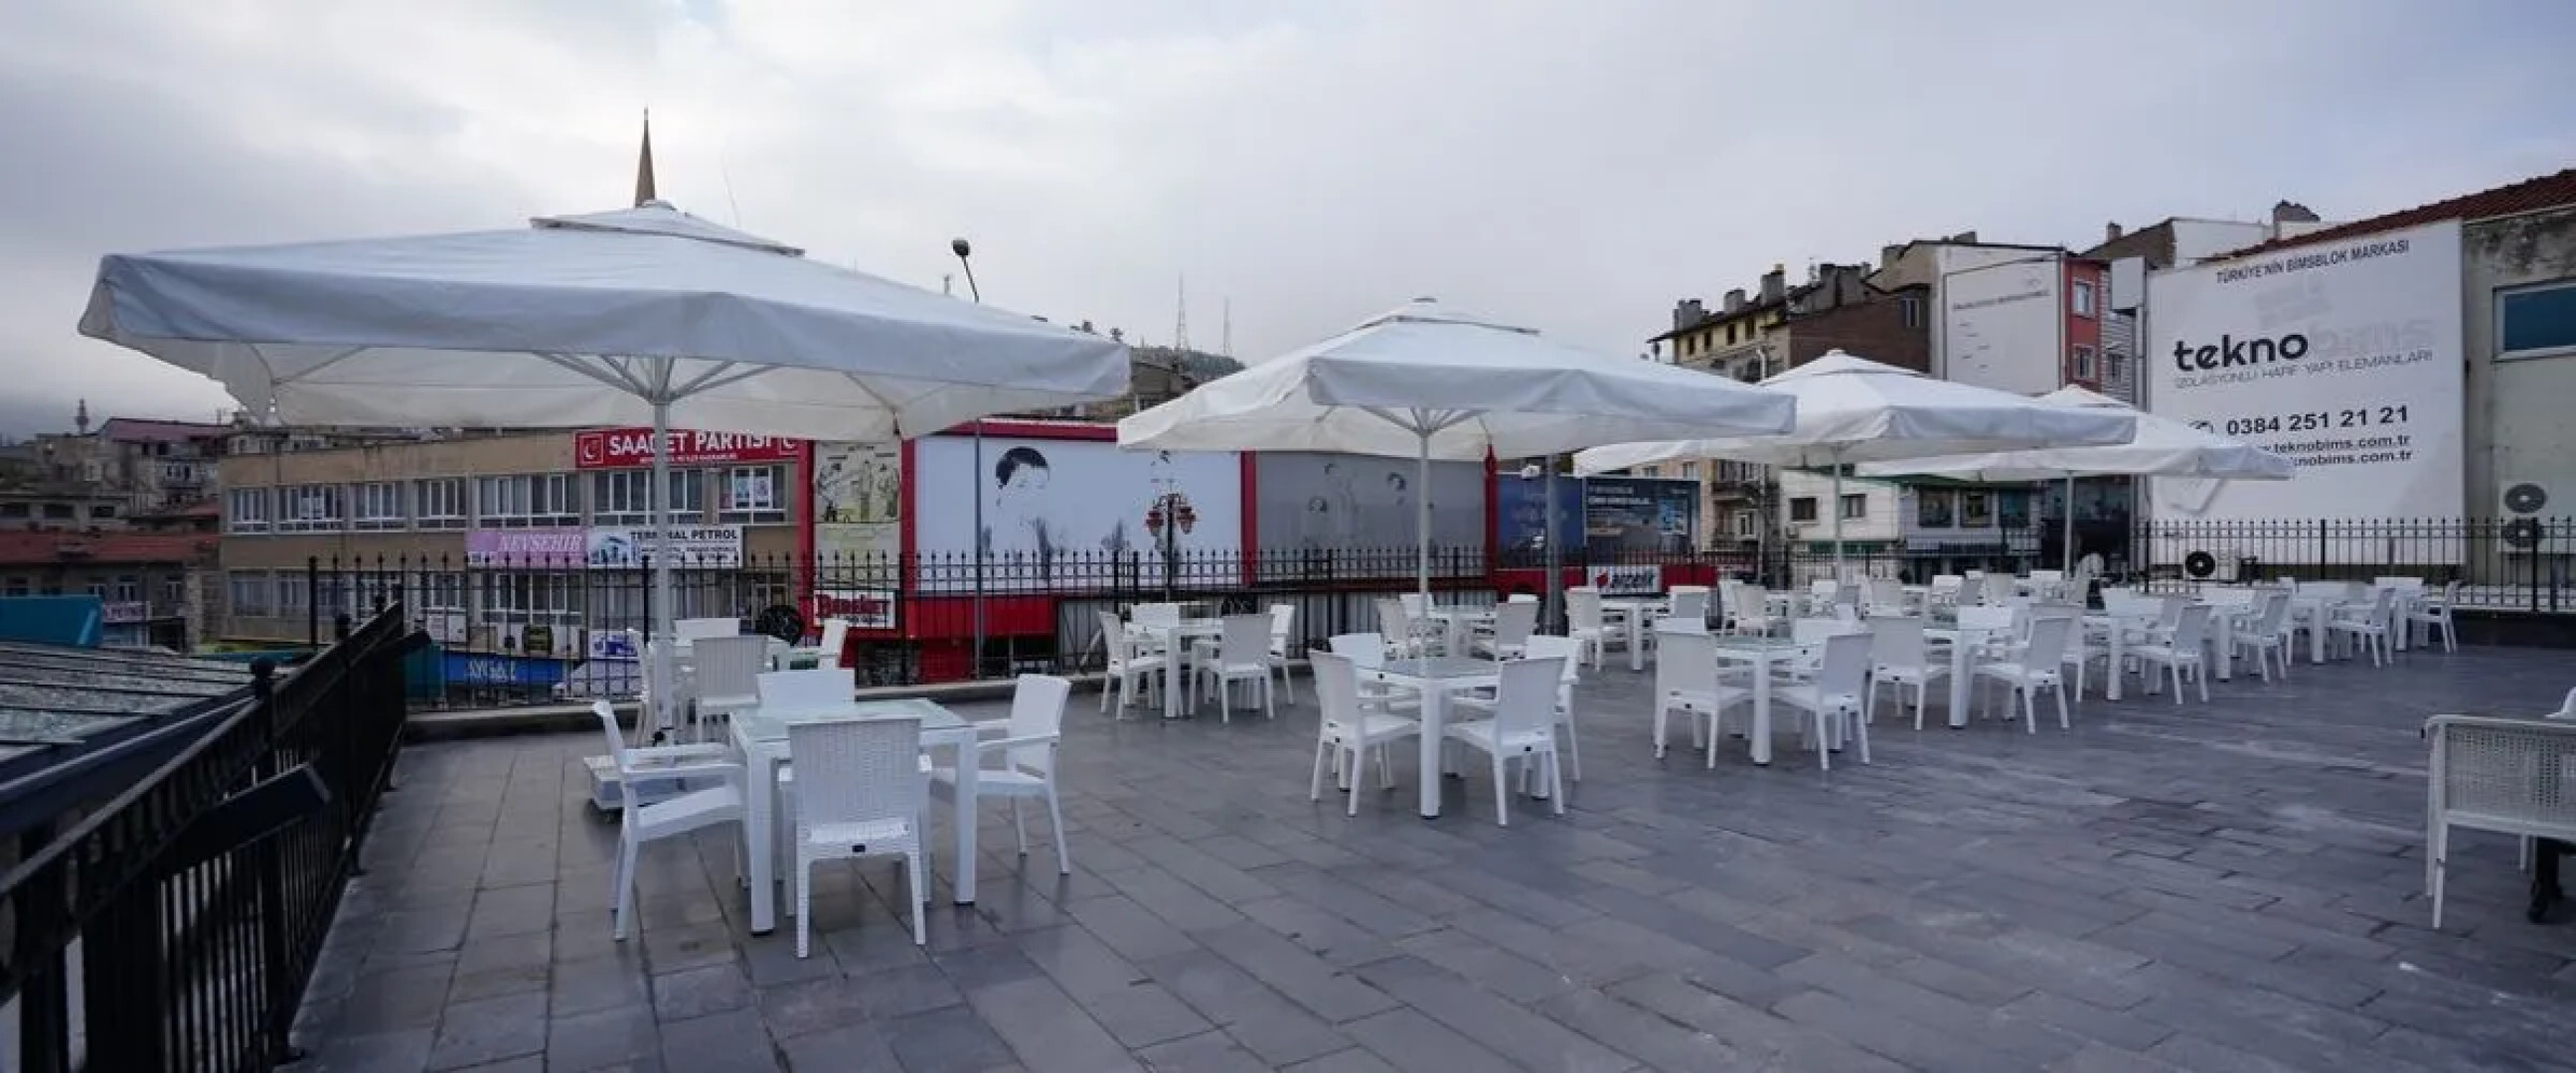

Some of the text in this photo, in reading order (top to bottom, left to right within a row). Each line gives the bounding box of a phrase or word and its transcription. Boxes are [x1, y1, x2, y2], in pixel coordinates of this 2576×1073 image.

[2216, 239, 2410, 283] TÜRKİYE'NİN BİMSBLOK MARKASI
[2226, 405, 2408, 435] 0384 251 21 21
[691, 529, 737, 539] PETROL
